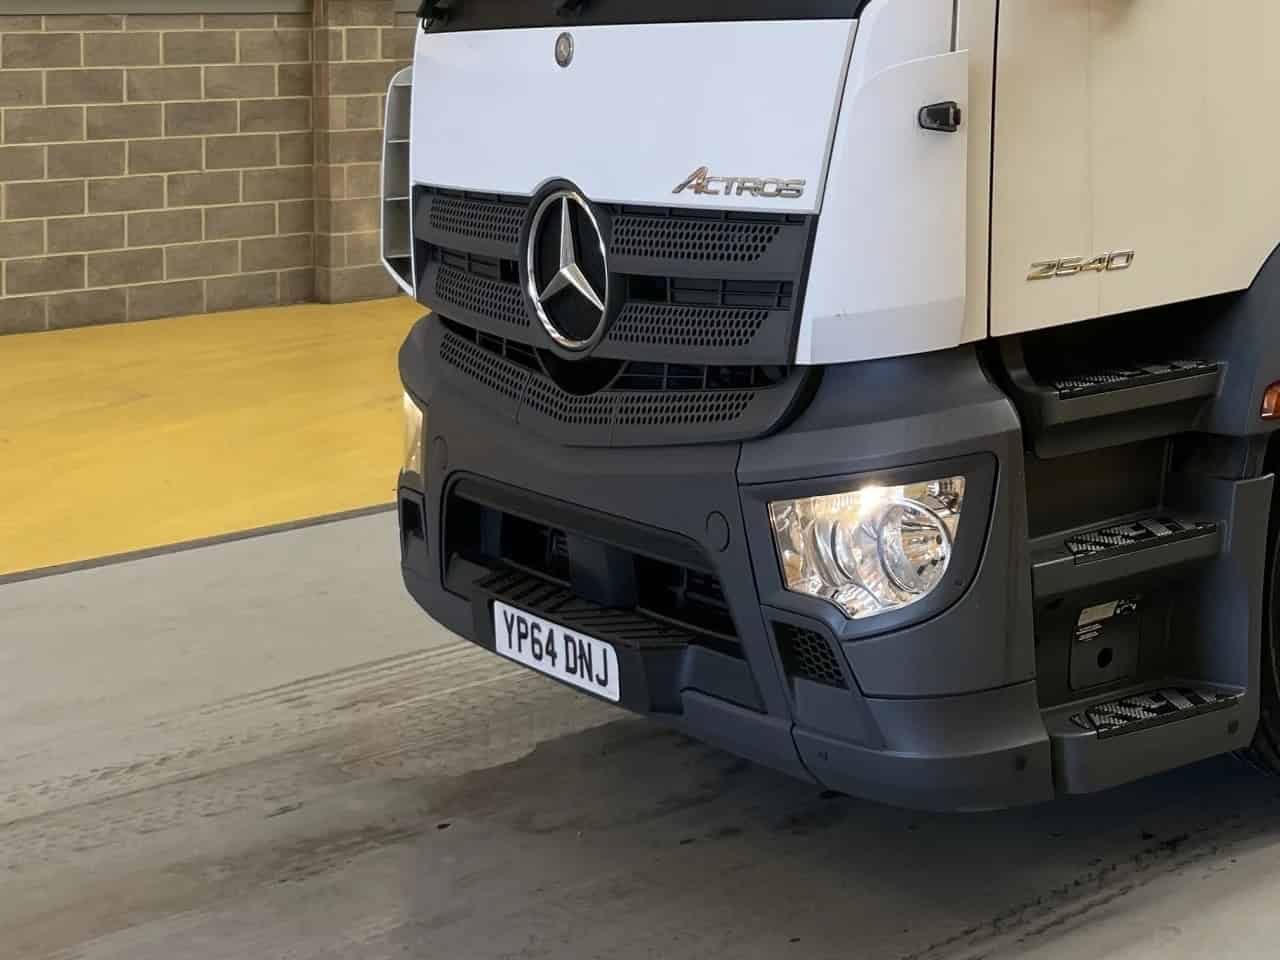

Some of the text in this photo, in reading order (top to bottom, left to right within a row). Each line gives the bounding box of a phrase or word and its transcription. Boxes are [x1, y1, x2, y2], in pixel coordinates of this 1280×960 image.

[672, 166, 806, 198] ACTROS
[1026, 249, 1135, 281] 2540
[503, 609, 609, 688] YP64 DNJ
